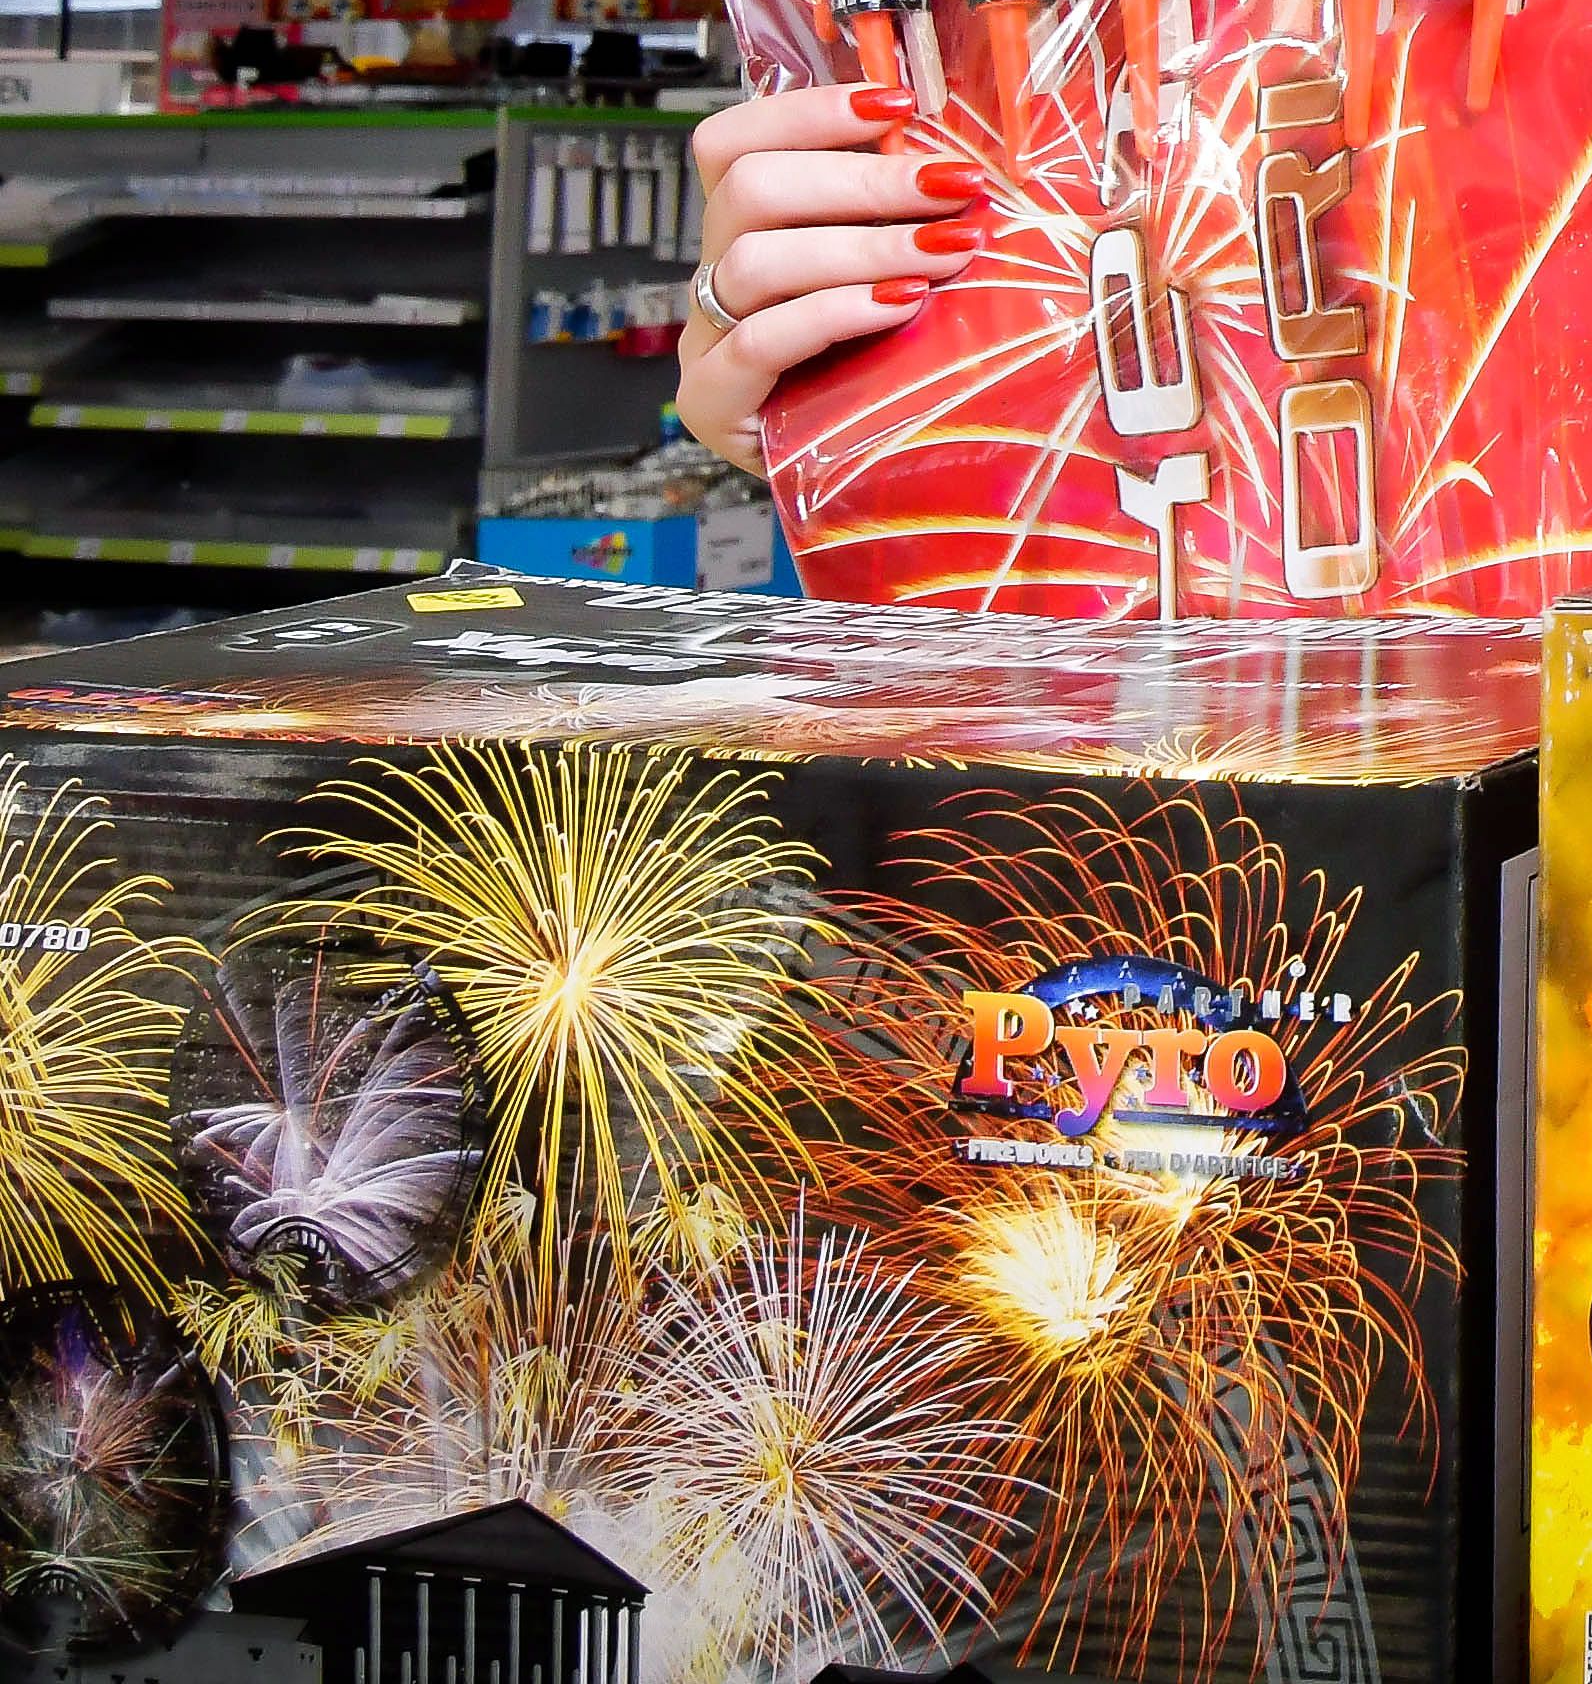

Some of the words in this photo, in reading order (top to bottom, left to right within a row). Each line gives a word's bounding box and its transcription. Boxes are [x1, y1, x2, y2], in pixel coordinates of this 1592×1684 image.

[1124, 982, 1353, 1023] PARTNER
[961, 991, 1287, 1137] Pyro
[968, 1138, 1093, 1168] FIREWORKS
